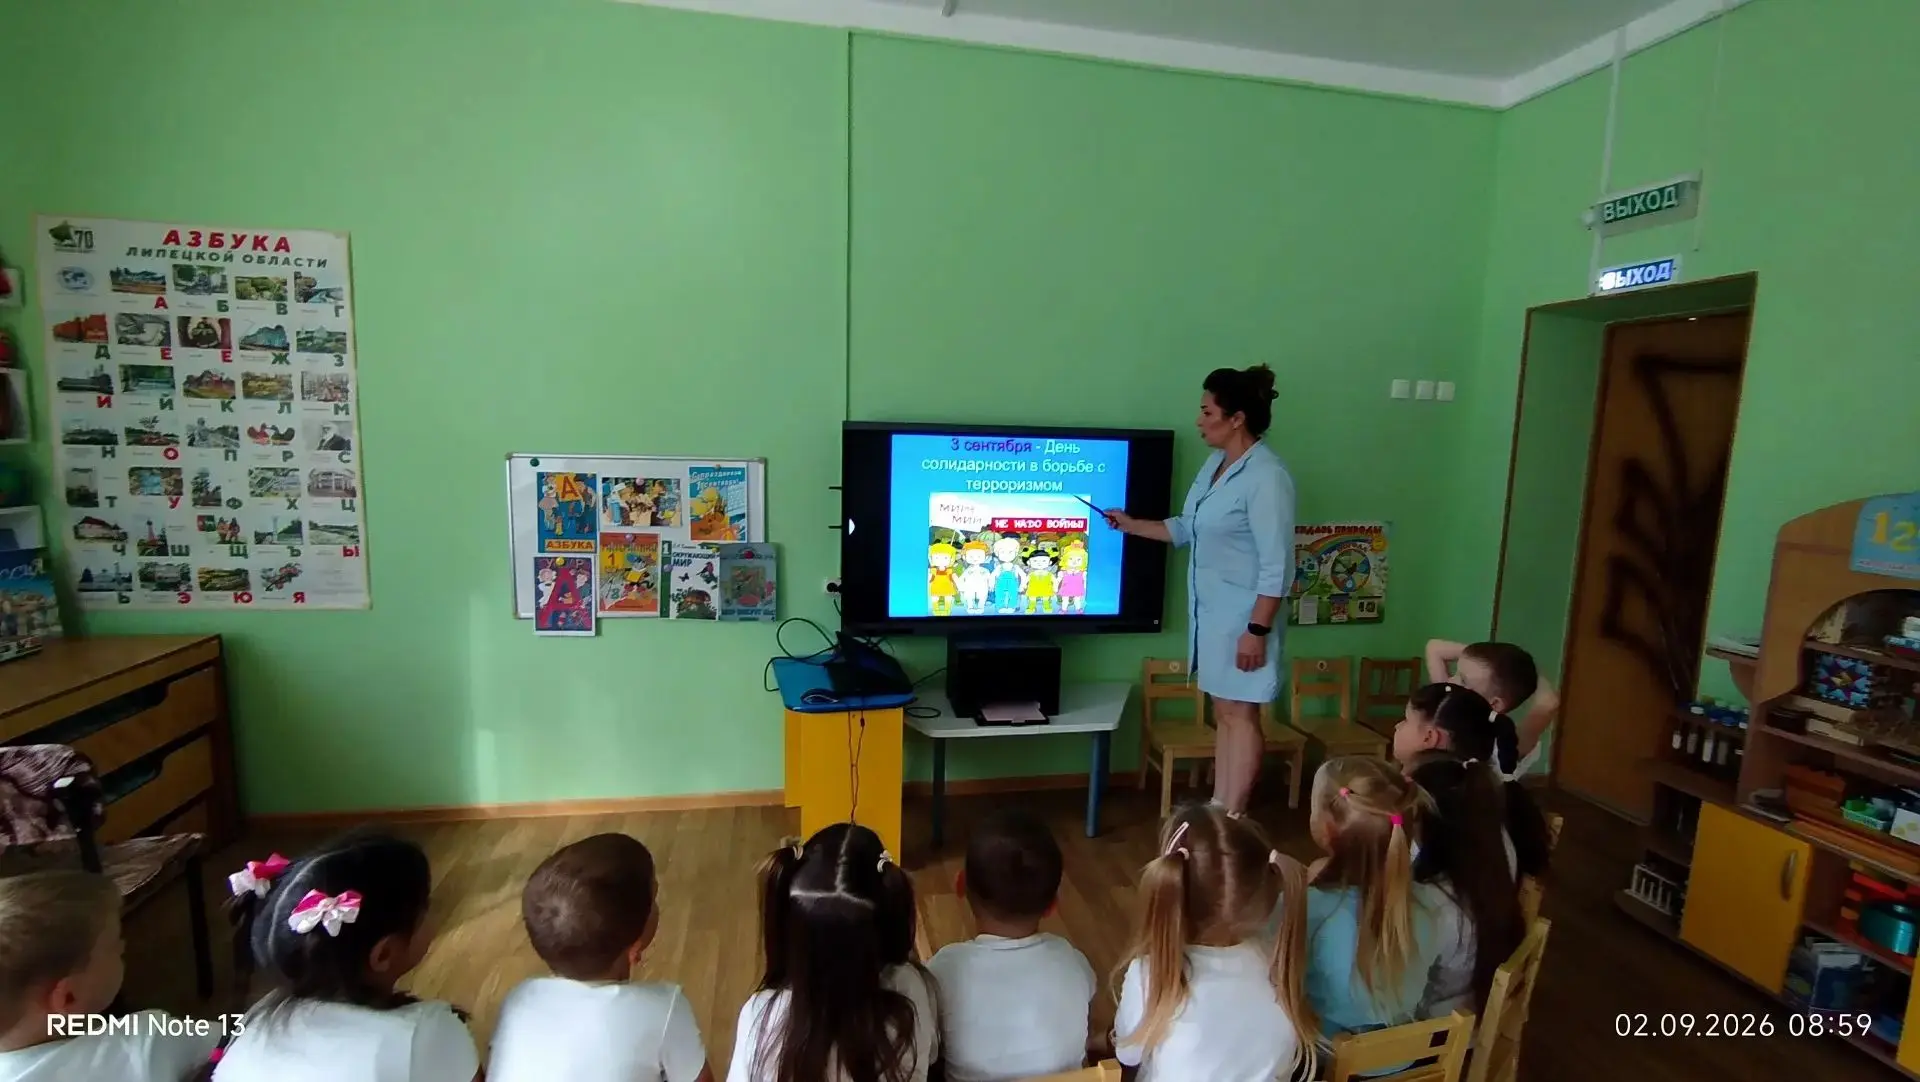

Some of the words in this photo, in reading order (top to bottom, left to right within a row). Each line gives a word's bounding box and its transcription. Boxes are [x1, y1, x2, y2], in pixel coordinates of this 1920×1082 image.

[1603, 185, 1678, 222] ВЫХОД
[74, 230, 94, 249] 70
[162, 229, 292, 253] АЗБУКА
[125, 246, 235, 264] ЛИПЕЦКОЙ
[242, 254, 328, 269] ОБЛАСТИ
[154, 297, 169, 310] А
[217, 300, 229, 313] Б
[276, 303, 288, 316] В
[334, 305, 345, 318] Г
[94, 345, 111, 360] Д
[160, 347, 173, 360] Е
[271, 352, 290, 365] Ж
[334, 355, 344, 367] З
[97, 396, 112, 409] И
[159, 393, 174, 411] Й
[221, 400, 234, 414] К
[277, 401, 292, 415] Л
[333, 403, 350, 416] М
[101, 446, 116, 459] Н
[163, 447, 179, 460] О
[224, 449, 237, 462] П
[281, 451, 294, 463] Р
[338, 451, 351, 464] С
[951, 437, 959, 451] 3
[964, 438, 1033, 454] сентября
[1044, 440, 1081, 456] День
[922, 459, 1026, 474] солидарности
[1030, 462, 1038, 471] в
[1042, 460, 1093, 475] борьбе
[1098, 463, 1106, 472] с
[561, 475, 579, 499] А
[966, 478, 1063, 493] терроризмом
[105, 496, 117, 508] Т
[168, 497, 181, 509] У
[226, 496, 243, 510] Ф
[286, 498, 299, 511] Х
[341, 499, 355, 513] Ц
[994, 519, 1009, 529] НЕ
[1014, 518, 1043, 529] НАДО
[1871, 511, 1920, 553] 12
[113, 544, 126, 557] Ч
[171, 545, 190, 557] Ш
[230, 545, 248, 560] Щ
[287, 545, 301, 558] Ъ
[342, 545, 360, 558] Ы
[547, 541, 593, 549] АЗБУКА
[663, 543, 669, 554] 1
[608, 552, 615, 565] 1
[673, 559, 693, 567] МИР
[118, 593, 130, 604] Ь
[177, 592, 191, 605] Э
[233, 592, 253, 604] Ю
[292, 592, 305, 604] Я
